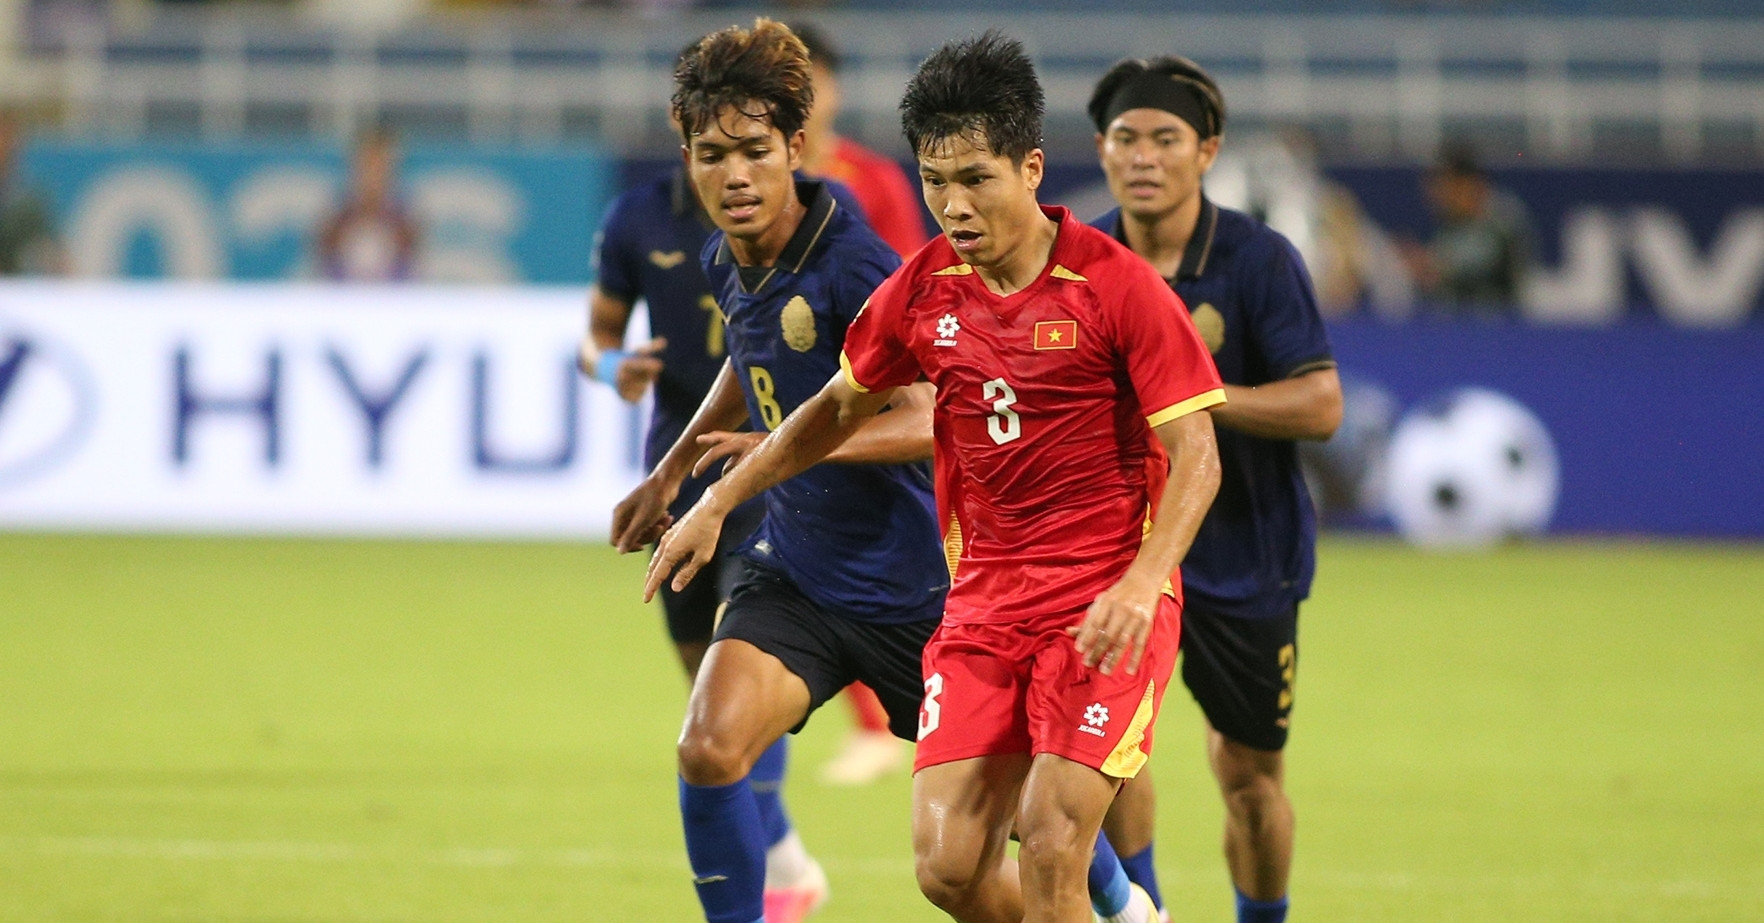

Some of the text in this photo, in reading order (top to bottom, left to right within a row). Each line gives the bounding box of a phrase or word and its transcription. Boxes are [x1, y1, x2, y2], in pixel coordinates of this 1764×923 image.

[171, 340, 643, 474] HYU
[749, 366, 783, 433] 8
[982, 377, 1021, 446] 3
[917, 672, 944, 742] 3
